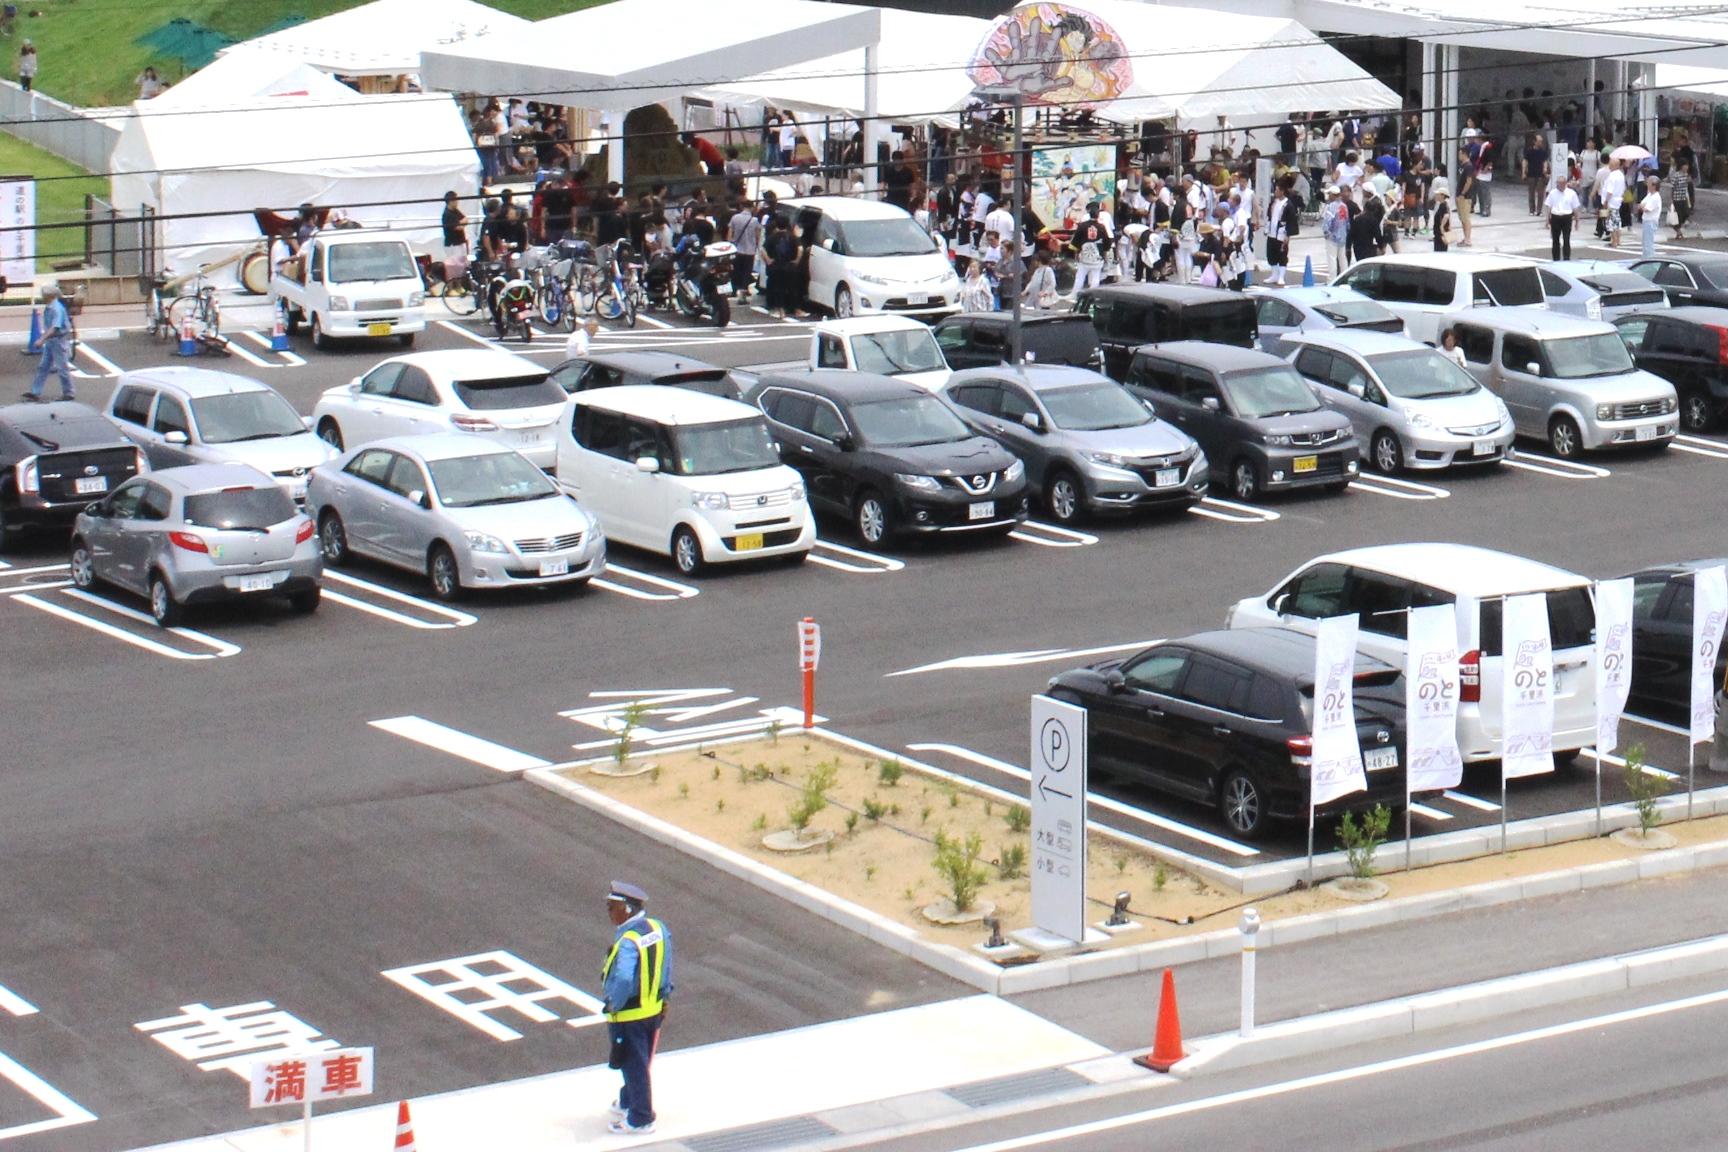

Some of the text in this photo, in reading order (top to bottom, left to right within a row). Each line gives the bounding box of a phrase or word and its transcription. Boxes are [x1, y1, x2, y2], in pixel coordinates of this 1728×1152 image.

[1418, 678, 1454, 701] のと
[1515, 668, 1547, 689] のと
[1322, 689, 1346, 711] のと
[1051, 729, 1062, 762] P
[264, 1055, 362, 1104] 満車
